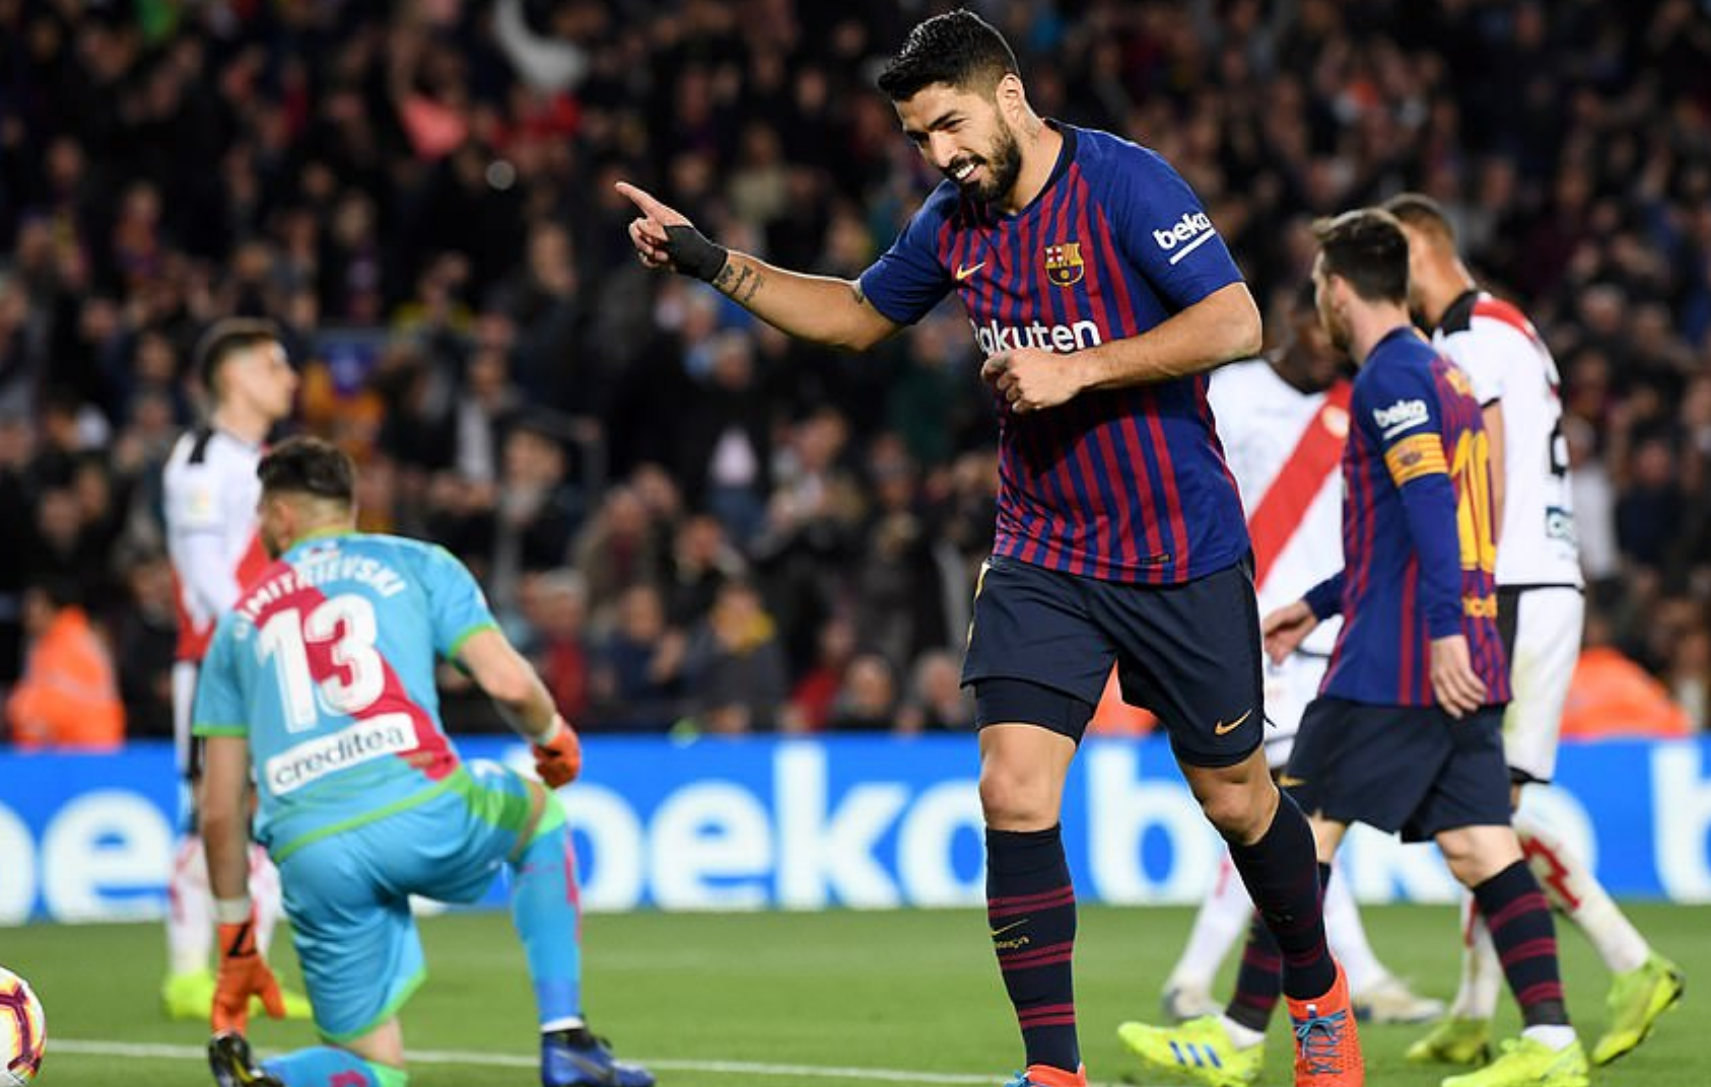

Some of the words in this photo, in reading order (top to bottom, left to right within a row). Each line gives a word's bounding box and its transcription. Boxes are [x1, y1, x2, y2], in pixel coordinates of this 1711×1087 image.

[1152, 212, 1212, 250] beko
[970, 318, 1102, 353] akuten
[1373, 400, 1427, 427] beko
[255, 592, 386, 734] 13
[273, 726, 406, 786] creditea
